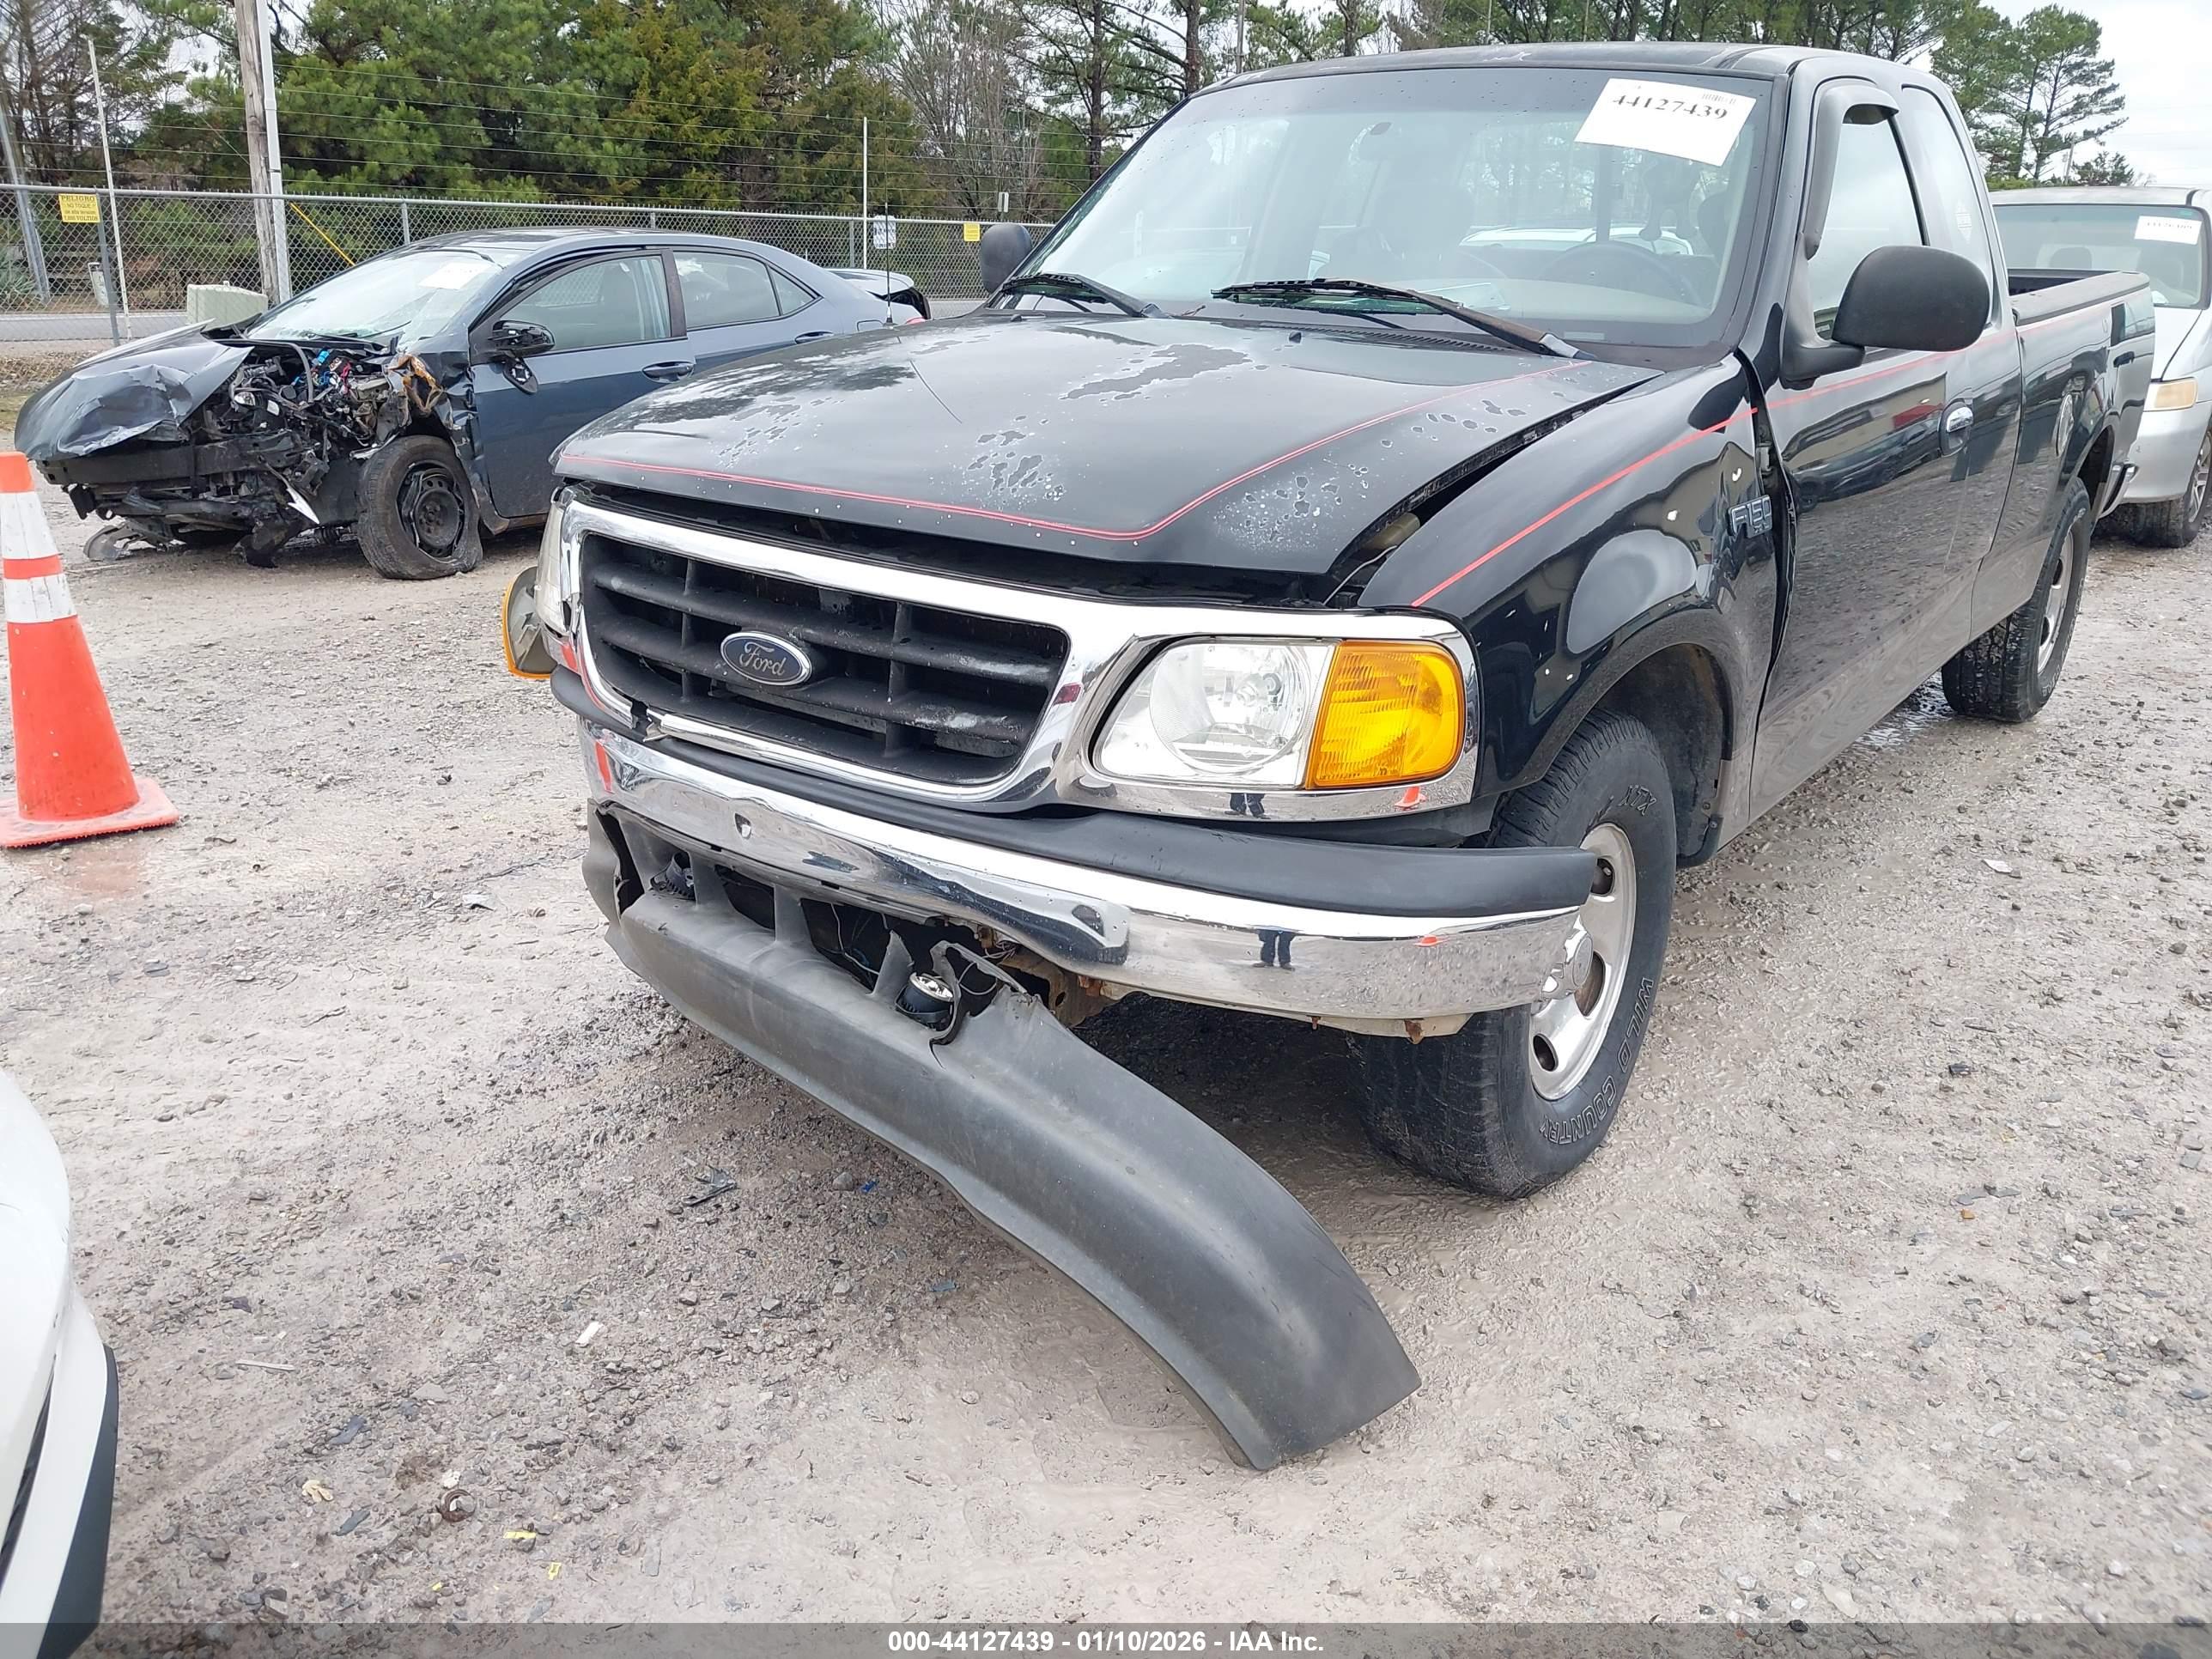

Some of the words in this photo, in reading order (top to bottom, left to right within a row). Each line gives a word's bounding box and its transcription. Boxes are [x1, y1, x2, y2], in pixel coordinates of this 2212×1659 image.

[1613, 94, 1728, 119] 44127439
[739, 641, 787, 676] Ford
[1617, 977, 1655, 1073] WILD
[1539, 1075, 1617, 1146] COUNTRY
